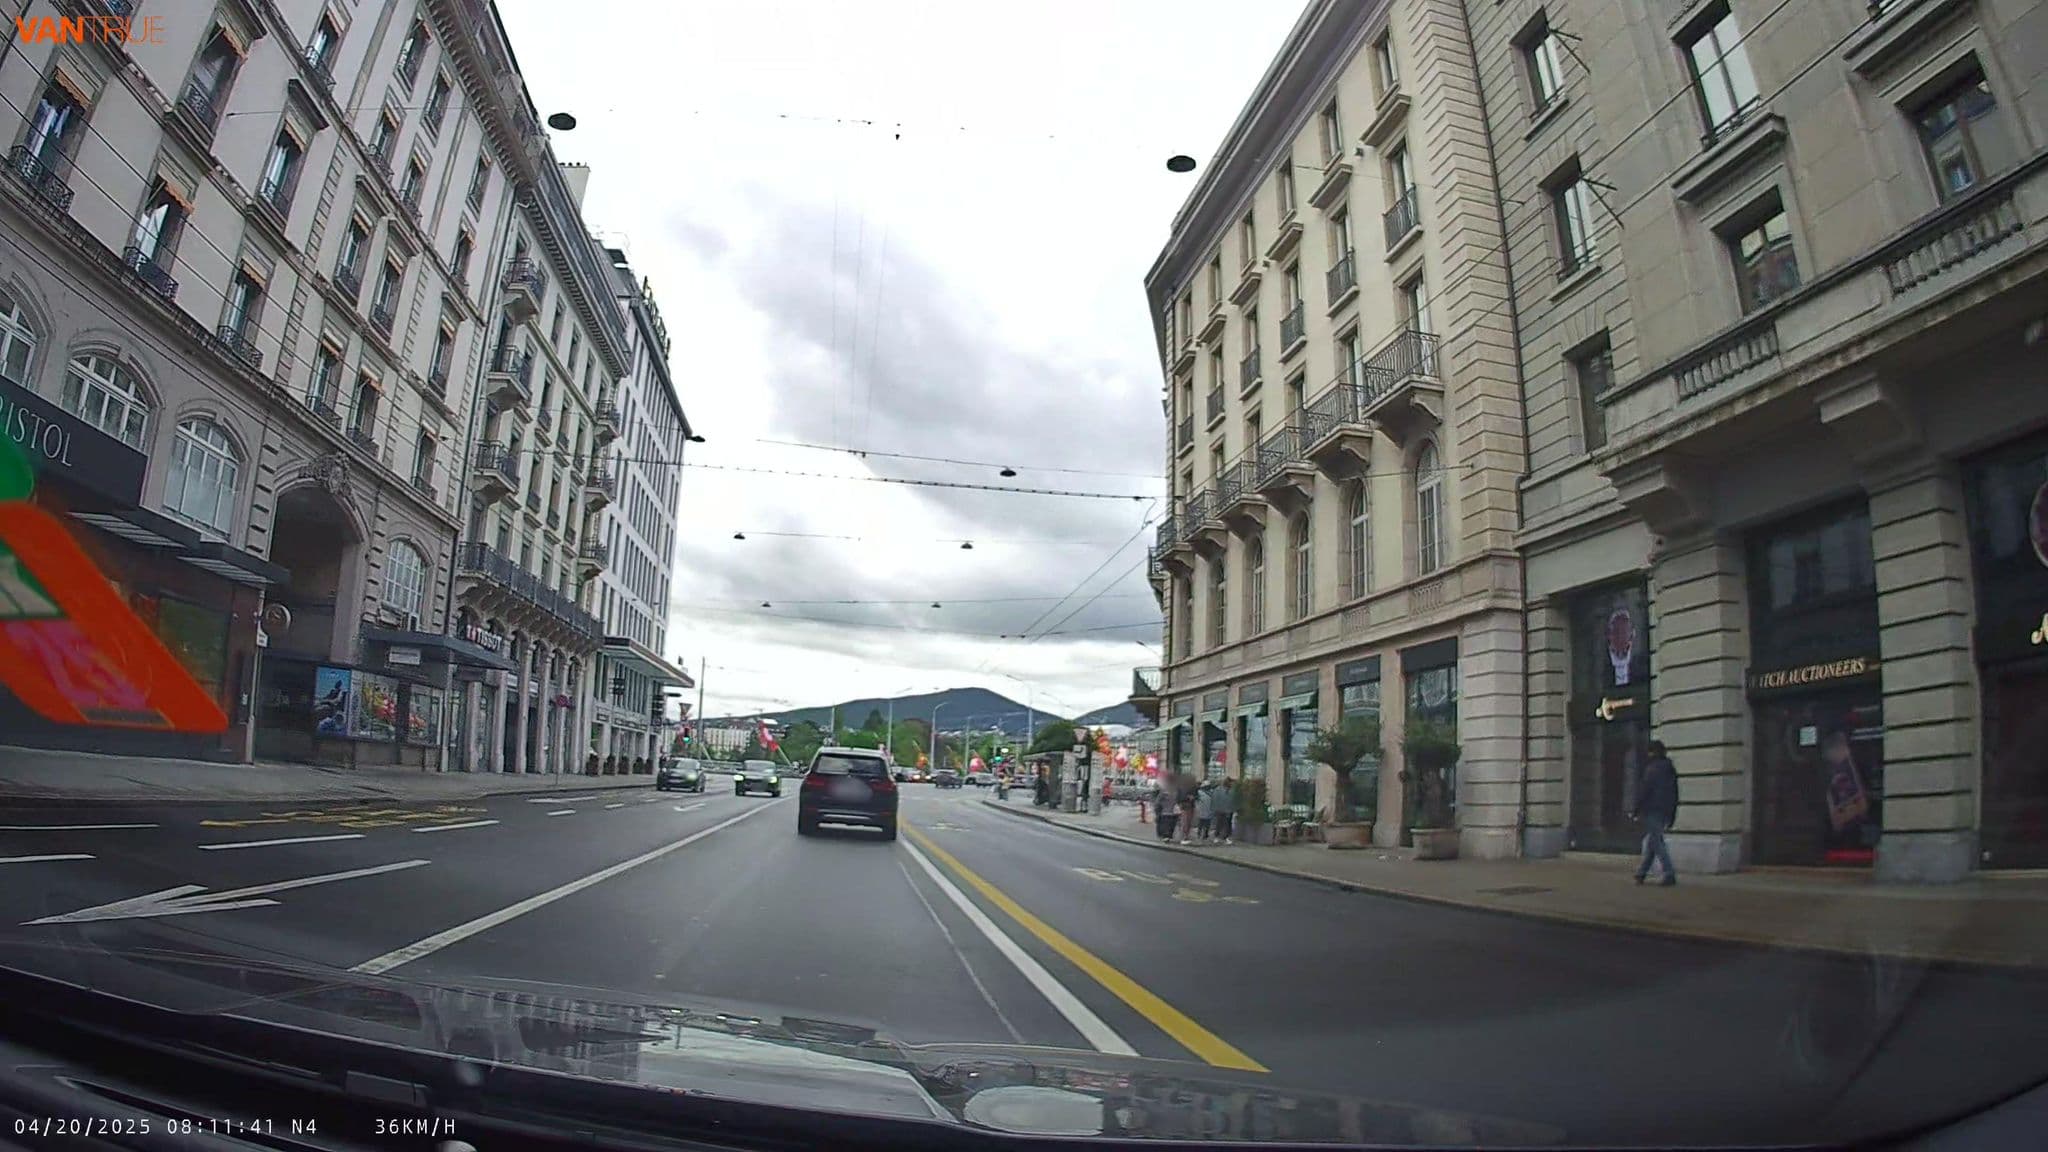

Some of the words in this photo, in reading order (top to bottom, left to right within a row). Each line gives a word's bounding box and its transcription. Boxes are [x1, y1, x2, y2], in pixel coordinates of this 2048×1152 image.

[0, 396, 72, 467] ISTOL
[476, 627, 503, 651] TISSOT
[1785, 658, 1865, 685] AUCTIONEERS
